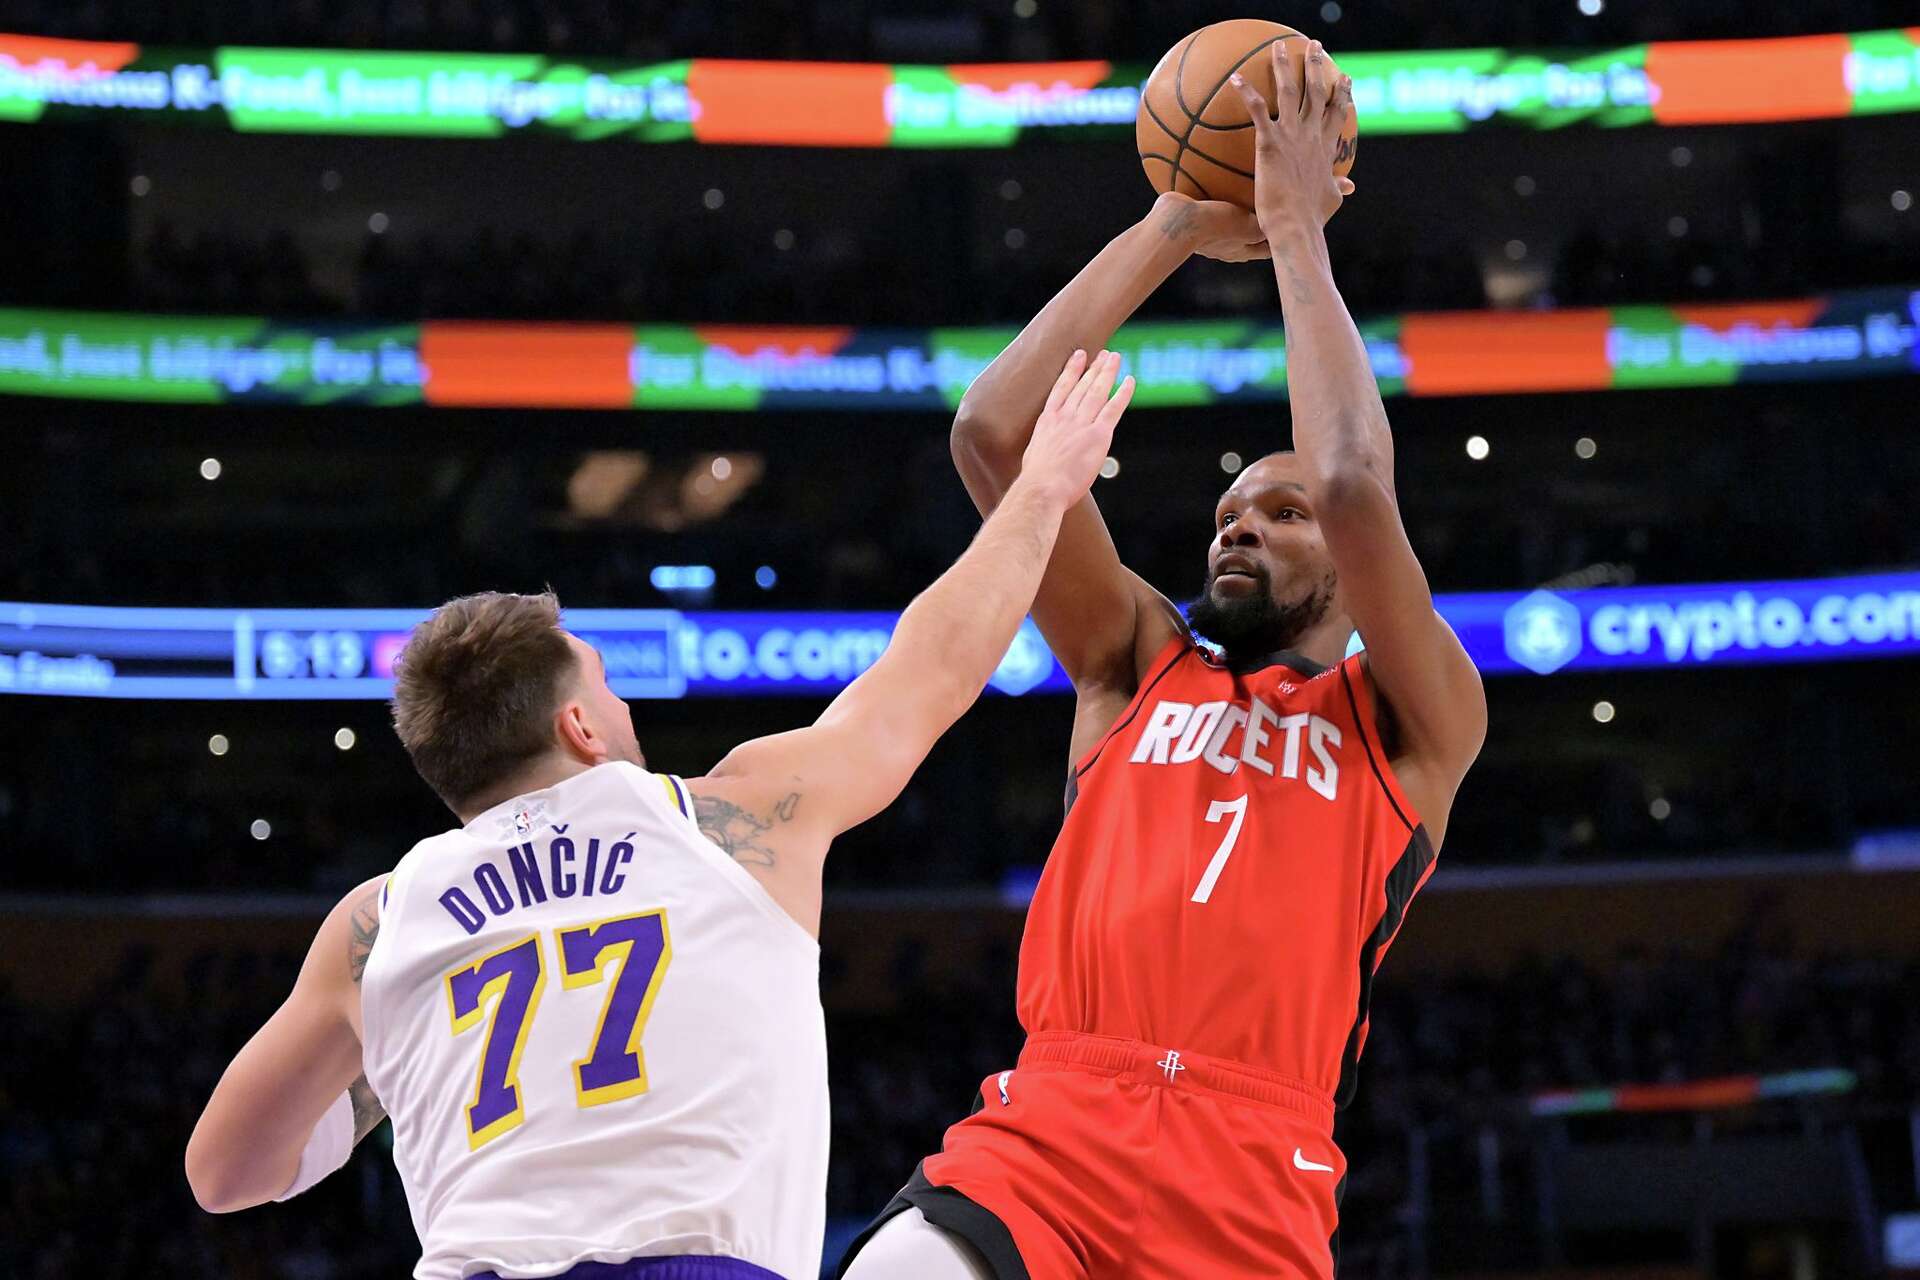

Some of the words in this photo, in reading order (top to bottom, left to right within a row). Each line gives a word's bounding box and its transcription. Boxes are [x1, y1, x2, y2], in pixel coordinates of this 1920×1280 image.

[1128, 695, 1342, 801] ROCETS
[438, 824, 637, 935] DONČIĆ
[1191, 793, 1248, 904] 7
[444, 908, 672, 1152] 77
